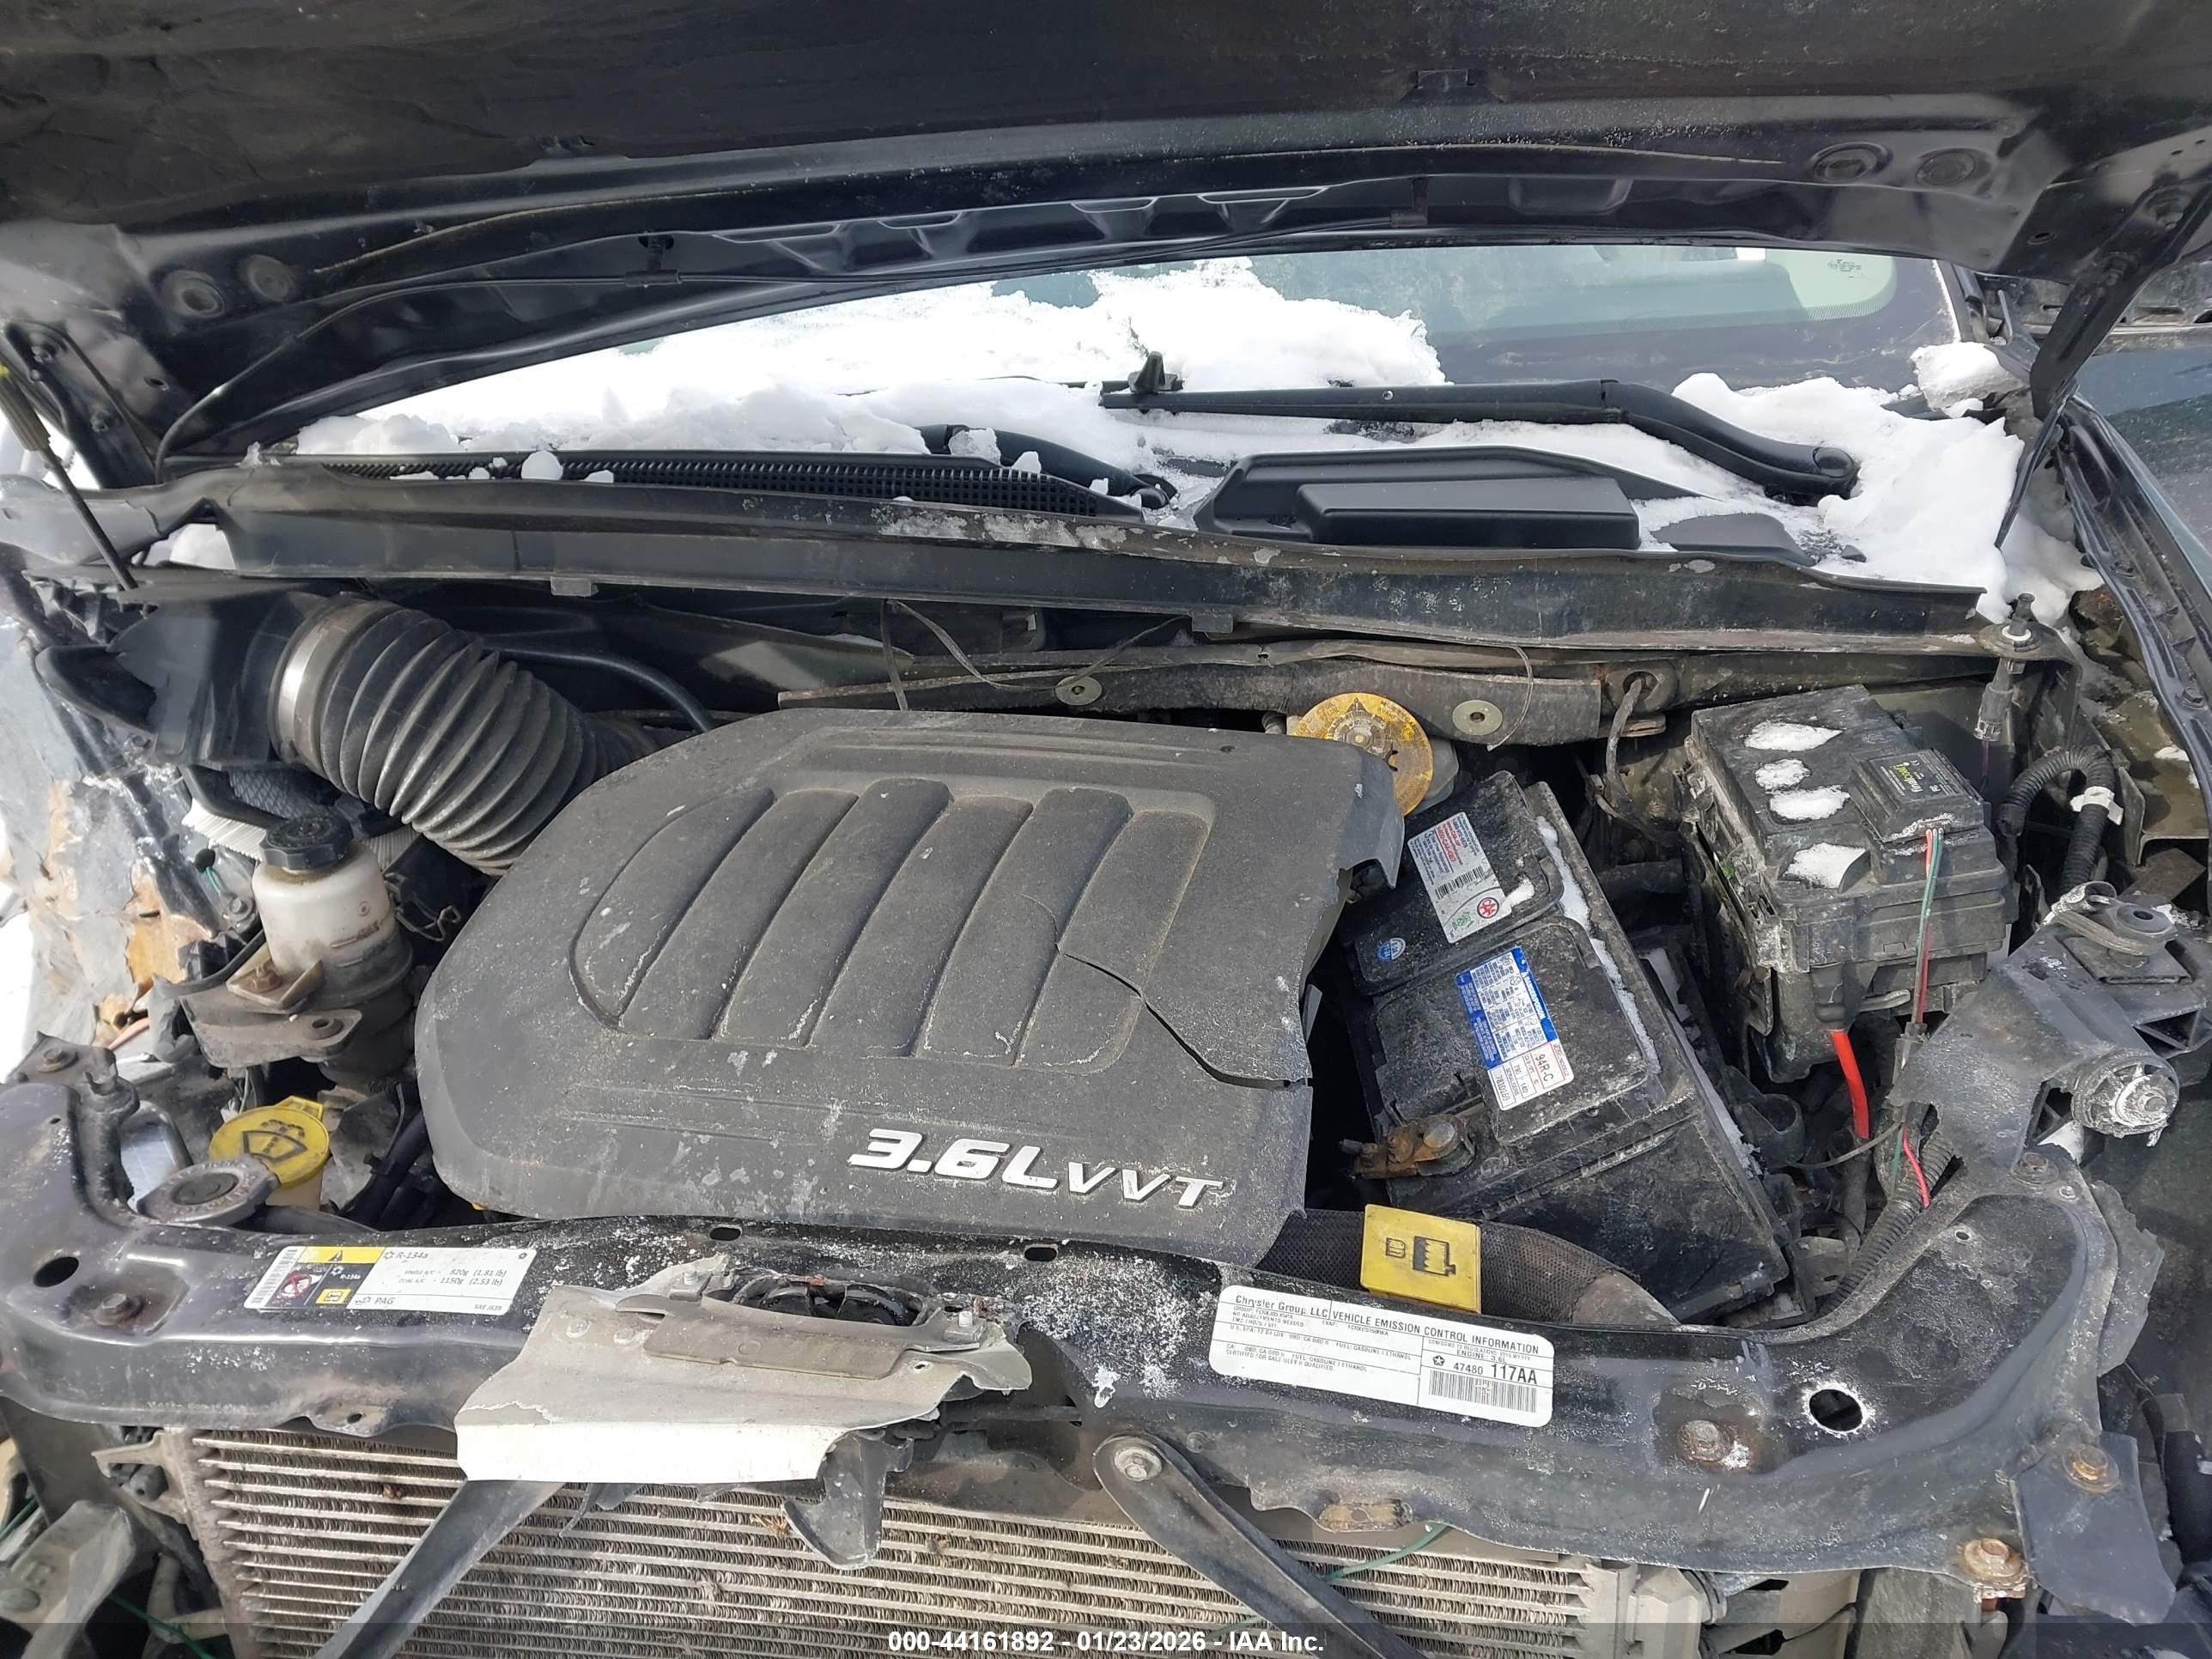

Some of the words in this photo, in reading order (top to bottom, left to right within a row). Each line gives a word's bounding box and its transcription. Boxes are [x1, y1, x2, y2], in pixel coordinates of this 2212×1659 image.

[1423, 830, 1435, 839] 3
[1534, 1053, 1553, 1082] 94R-C
[849, 1128, 1058, 1189] 3.6L
[1068, 1162, 1224, 1208] VVT
[396, 1250, 428, 1260] R-134a
[374, 1297, 393, 1305] PAG
[1236, 1295, 1274, 1310] Chrysler
[1279, 1302, 1307, 1315] Group
[1310, 1307, 1328, 1317] LLC
[1333, 1311, 1371, 1326] VEHICLE
[1375, 1317, 1420, 1334] EMISSION
[1424, 1326, 1468, 1343] CONTROL
[1472, 1335, 1539, 1355] INFORMATION
[1456, 1349, 1487, 1360] ENGINE:
[1453, 1362, 1483, 1375] 47480
[1491, 1363, 1537, 1384] 117AA
